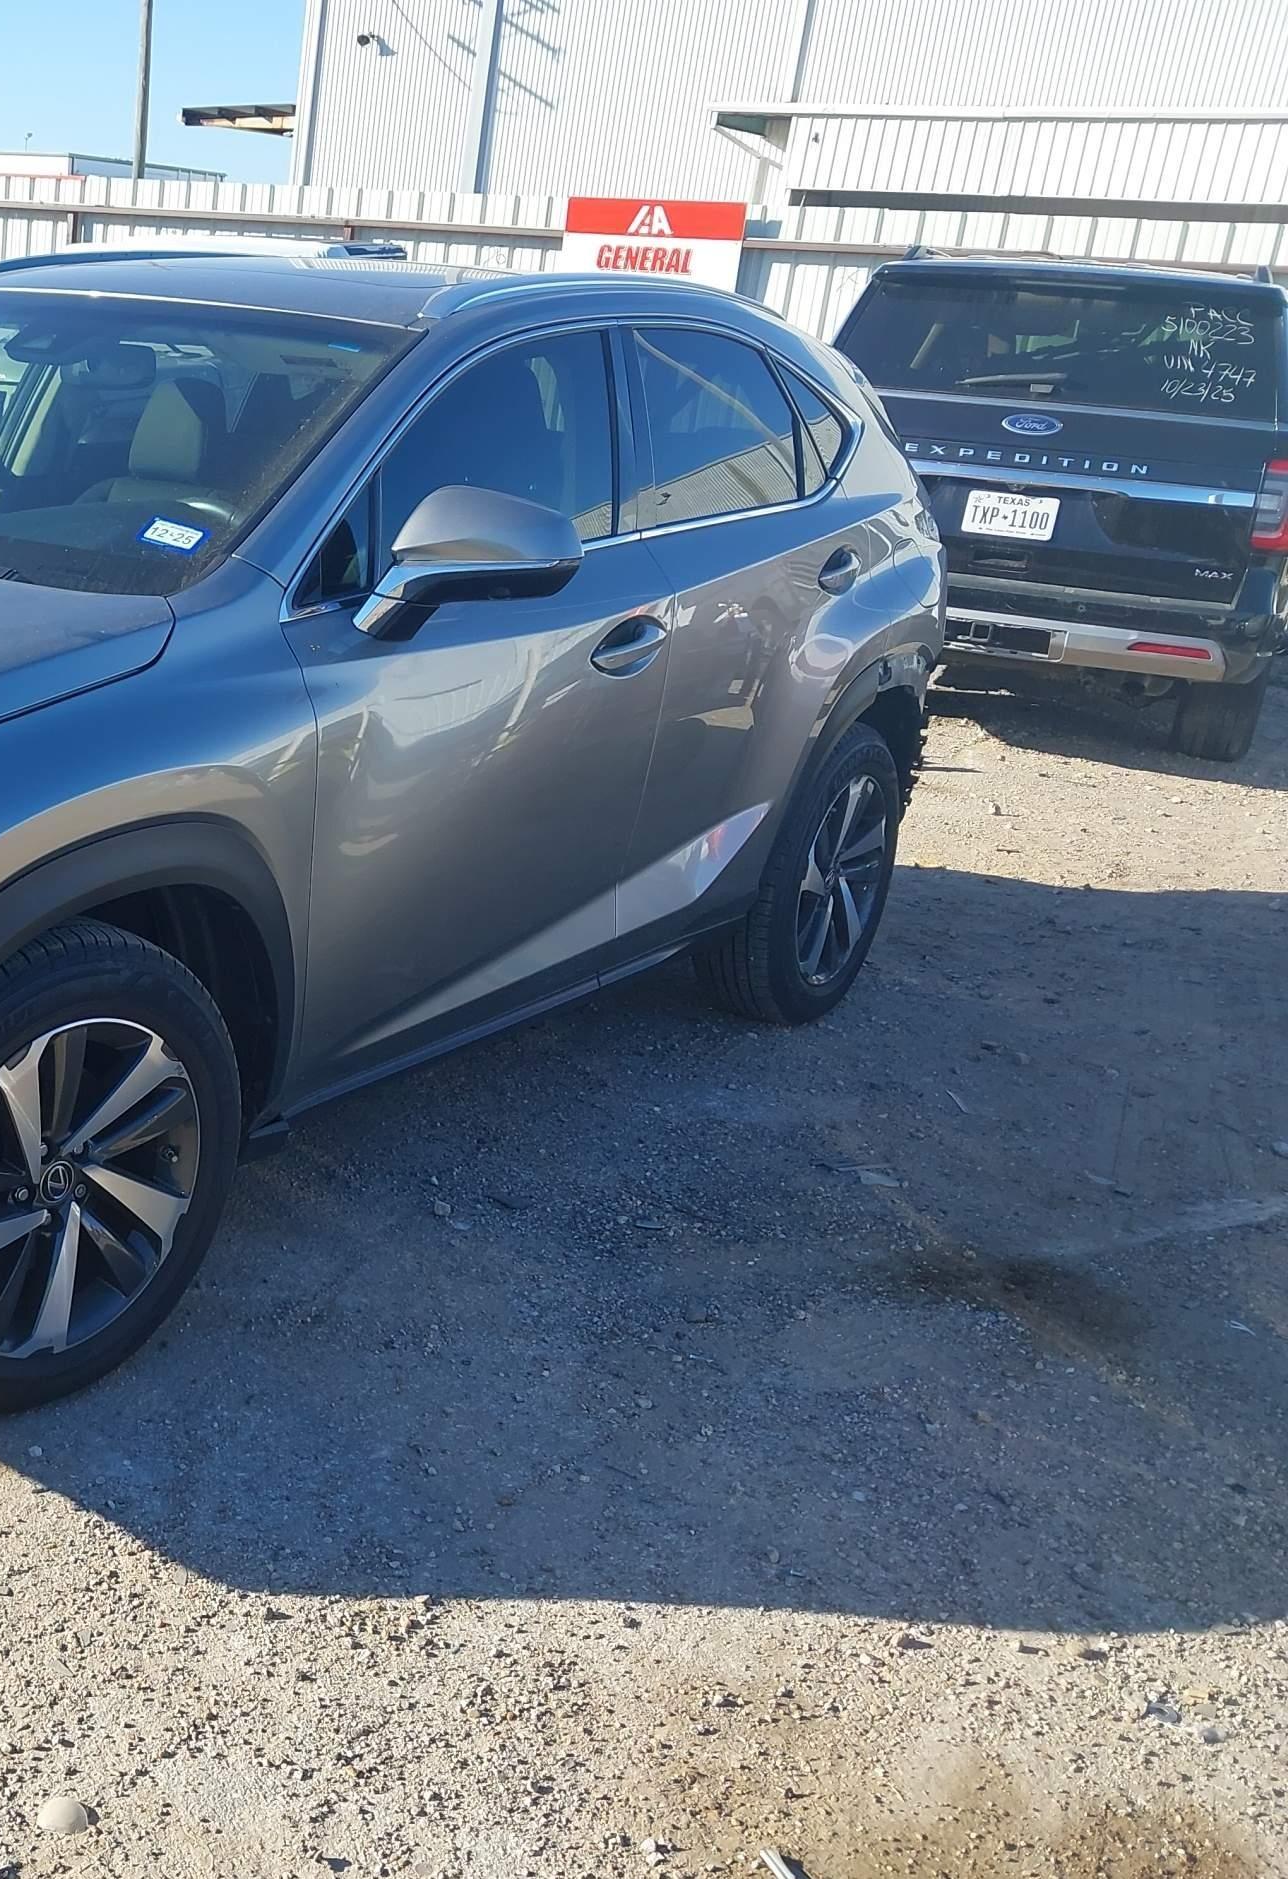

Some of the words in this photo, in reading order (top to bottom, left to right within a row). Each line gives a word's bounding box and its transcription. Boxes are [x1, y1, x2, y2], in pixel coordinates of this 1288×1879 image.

[597, 245, 692, 275] GENERAL
[1161, 315, 1255, 345] 5100223
[1201, 361, 1257, 388] 4747
[1160, 378, 1235, 403] 10/23/25
[1015, 416, 1048, 432] Ford
[905, 442, 1148, 474] EXPEDITION
[997, 496, 1031, 507] TEXAS
[1194, 568, 1235, 580] MAX
